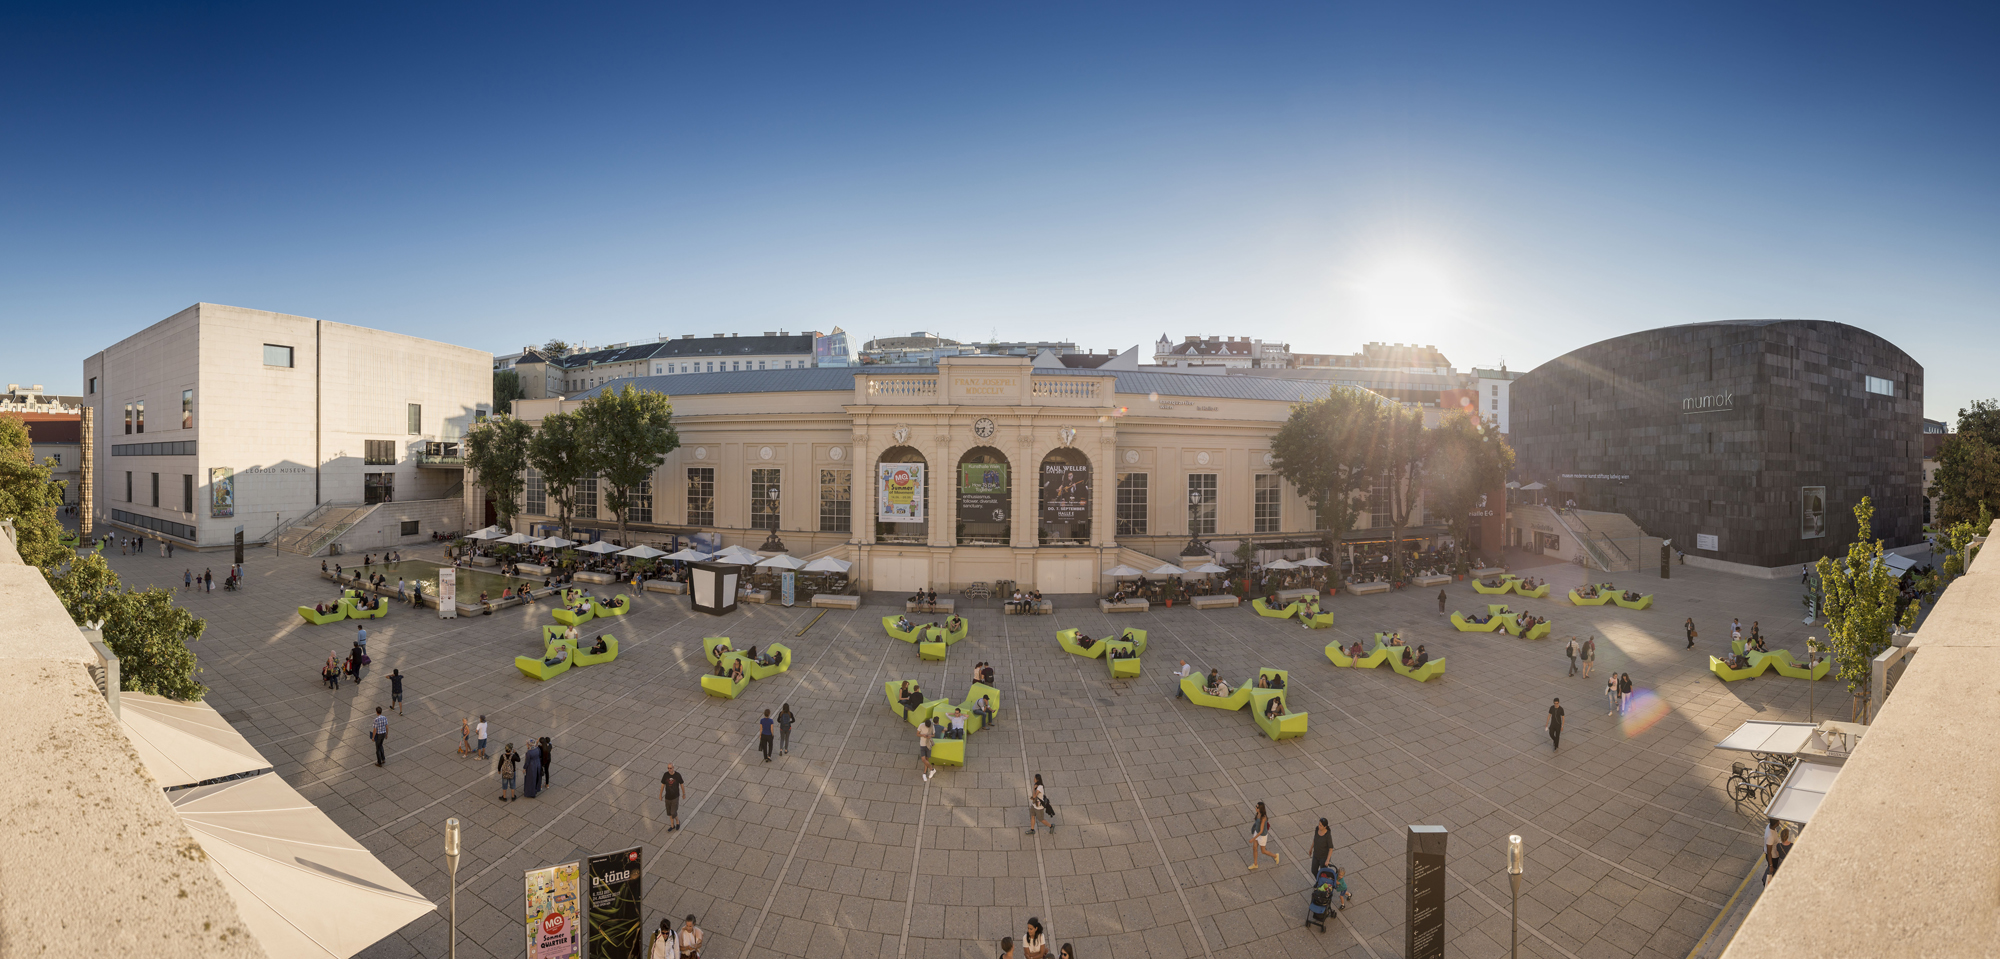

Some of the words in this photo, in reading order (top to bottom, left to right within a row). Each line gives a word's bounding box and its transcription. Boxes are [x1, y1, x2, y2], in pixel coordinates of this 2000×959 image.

[1682, 390, 1732, 410] mumok
[593, 870, 630, 885] o-töne
[545, 916, 563, 929] MQ
[541, 938, 567, 948] QUARTIER
[543, 933, 564, 942] Sommer
